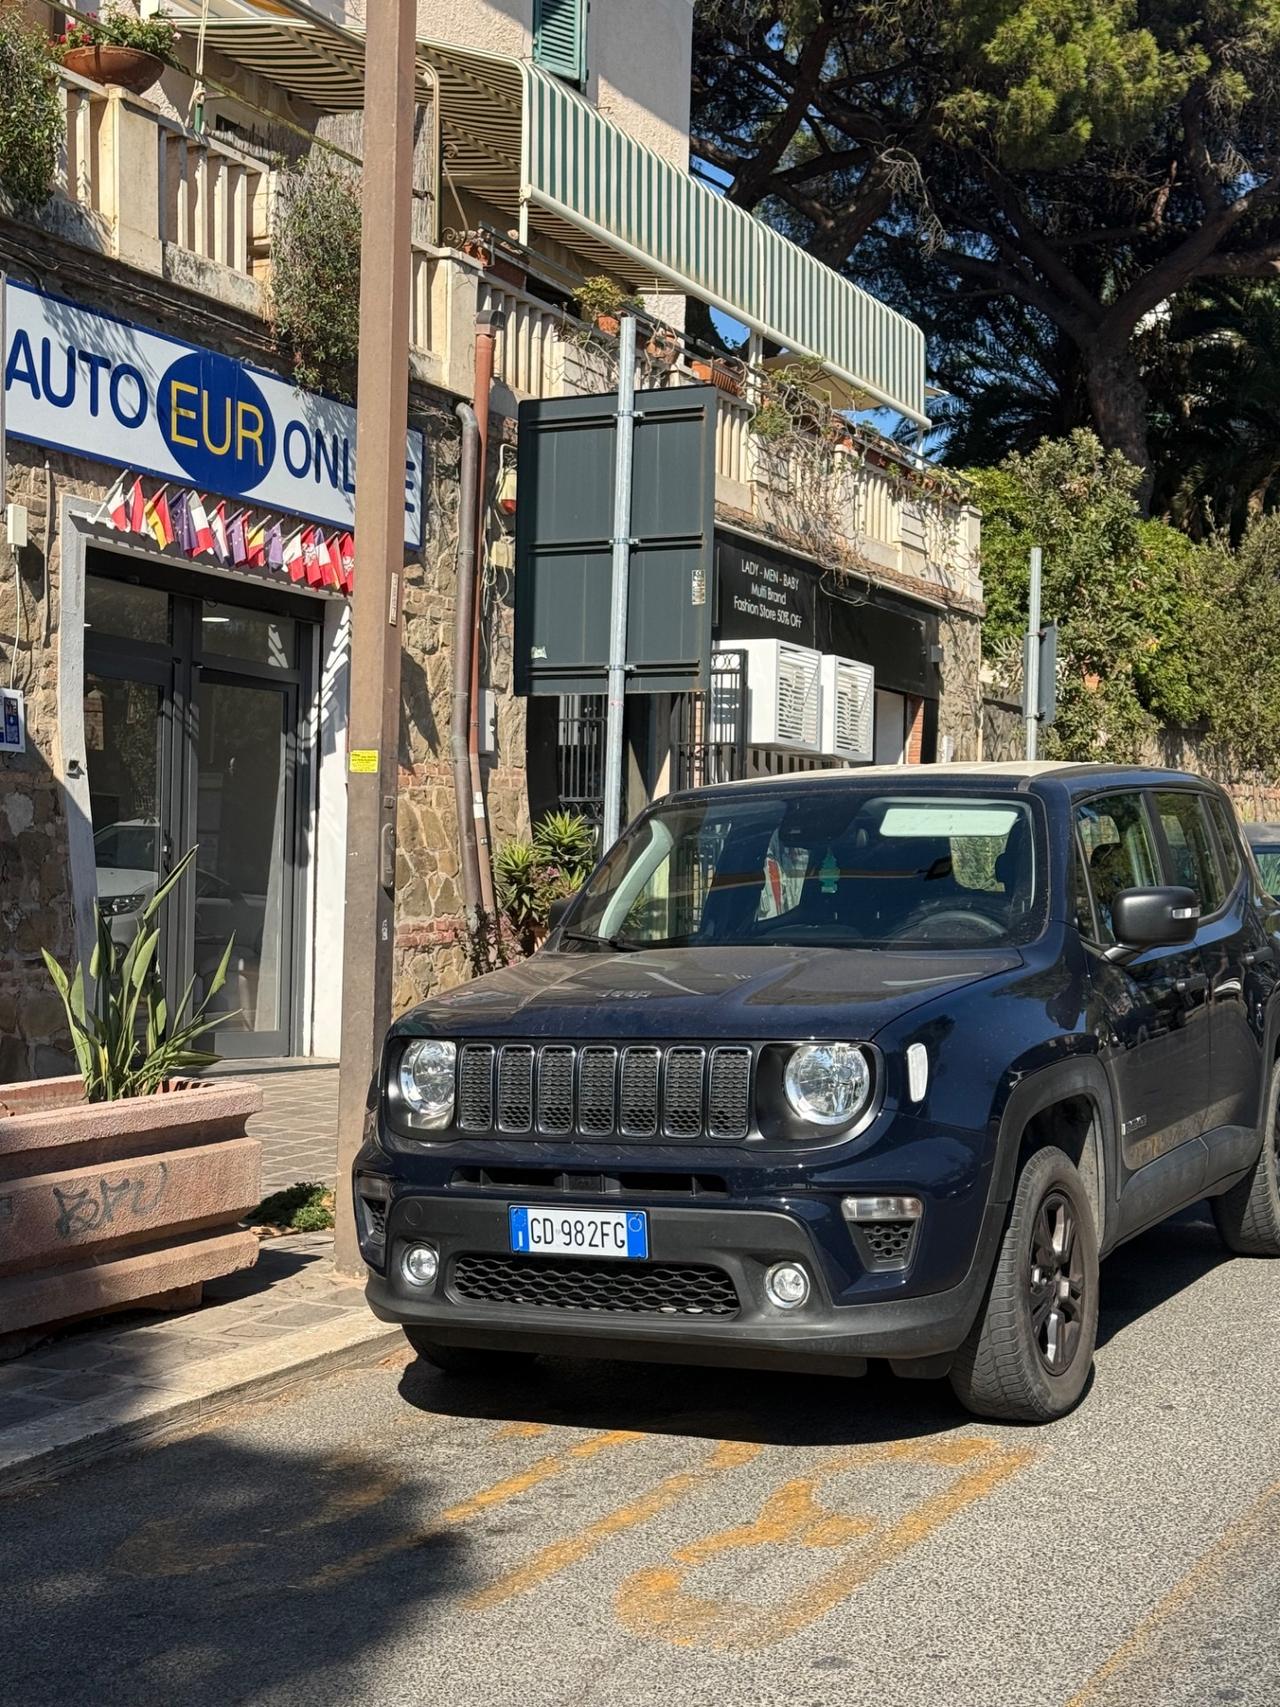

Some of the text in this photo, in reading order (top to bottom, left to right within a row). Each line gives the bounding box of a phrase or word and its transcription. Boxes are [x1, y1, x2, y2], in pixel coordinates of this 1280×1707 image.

[6, 329, 149, 429] AUTO
[170, 380, 265, 467] EUR
[741, 559, 759, 577] LADY
[763, 567, 779, 583] MEN
[783, 573, 800, 591] BABY
[751, 582, 787, 605] Multi Brand
[733, 595, 802, 629] Fashion Store 50% OFF
[530, 1218, 554, 1245] GD
[561, 1219, 626, 1249] 982FG
